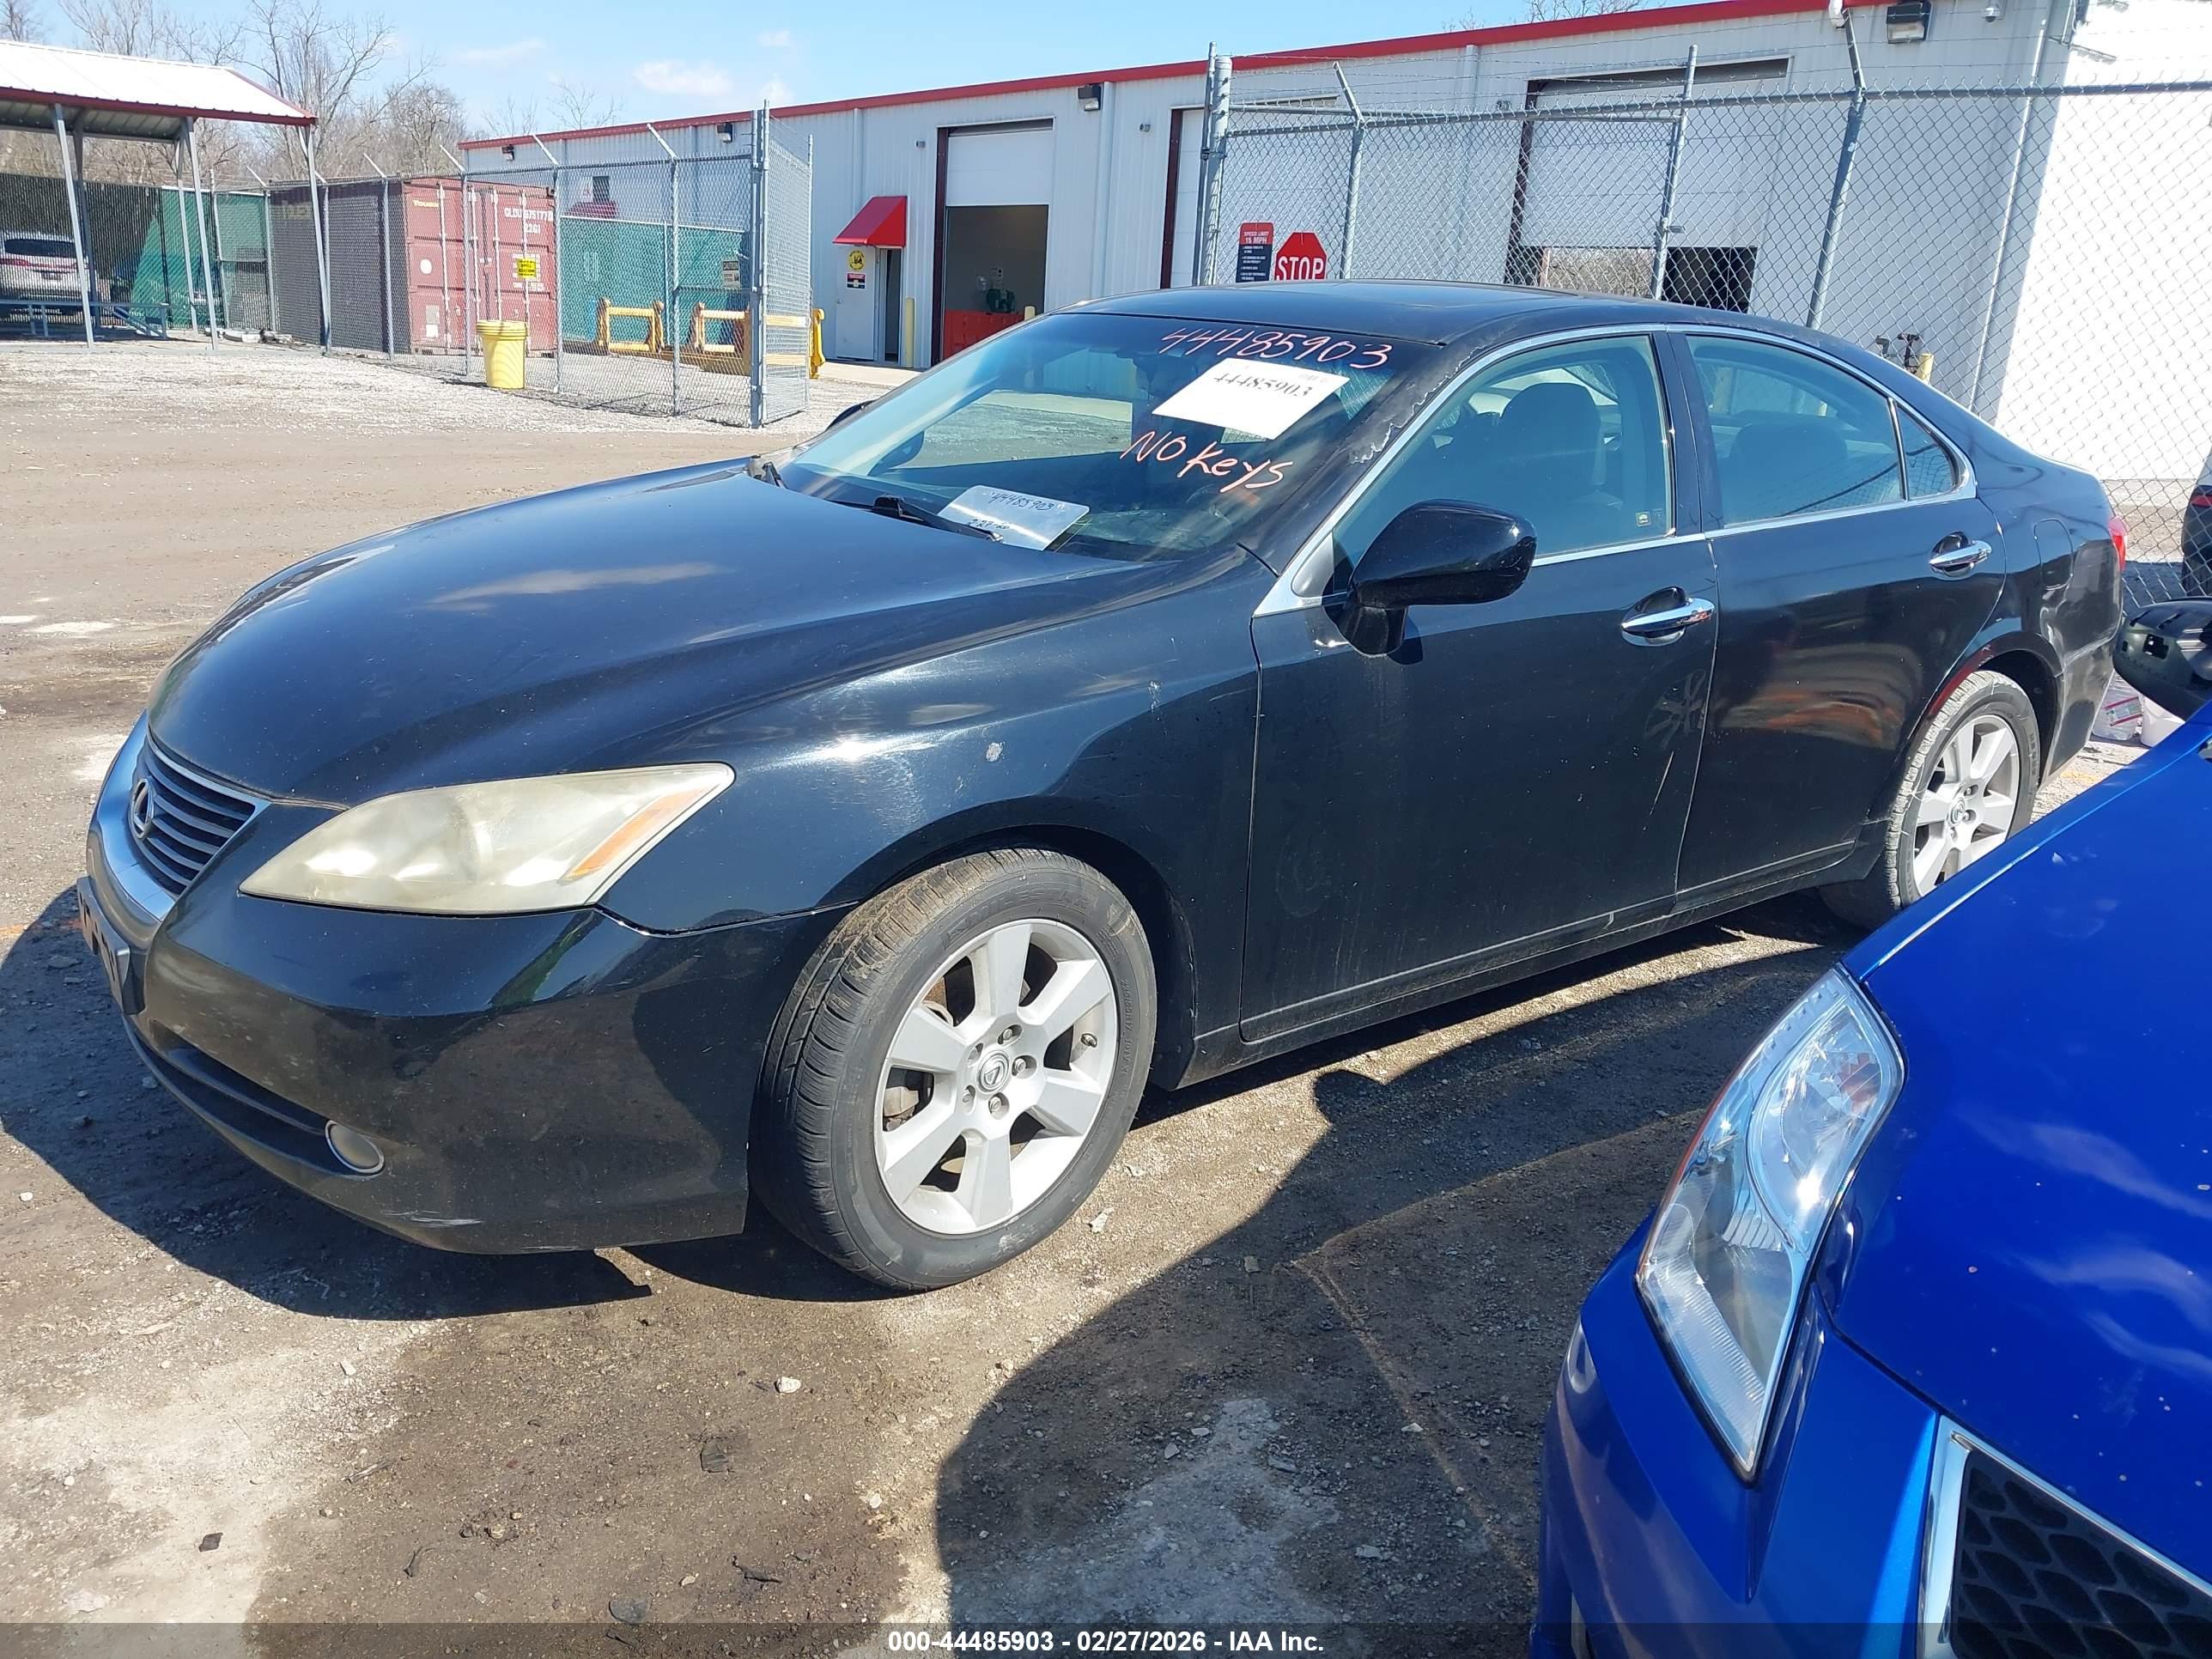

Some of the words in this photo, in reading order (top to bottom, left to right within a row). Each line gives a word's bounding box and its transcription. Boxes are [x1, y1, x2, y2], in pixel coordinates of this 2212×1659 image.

[1278, 256, 1324, 281] STOP
[1158, 327, 1394, 369] 44485903
[1213, 372, 1314, 398] 44485903
